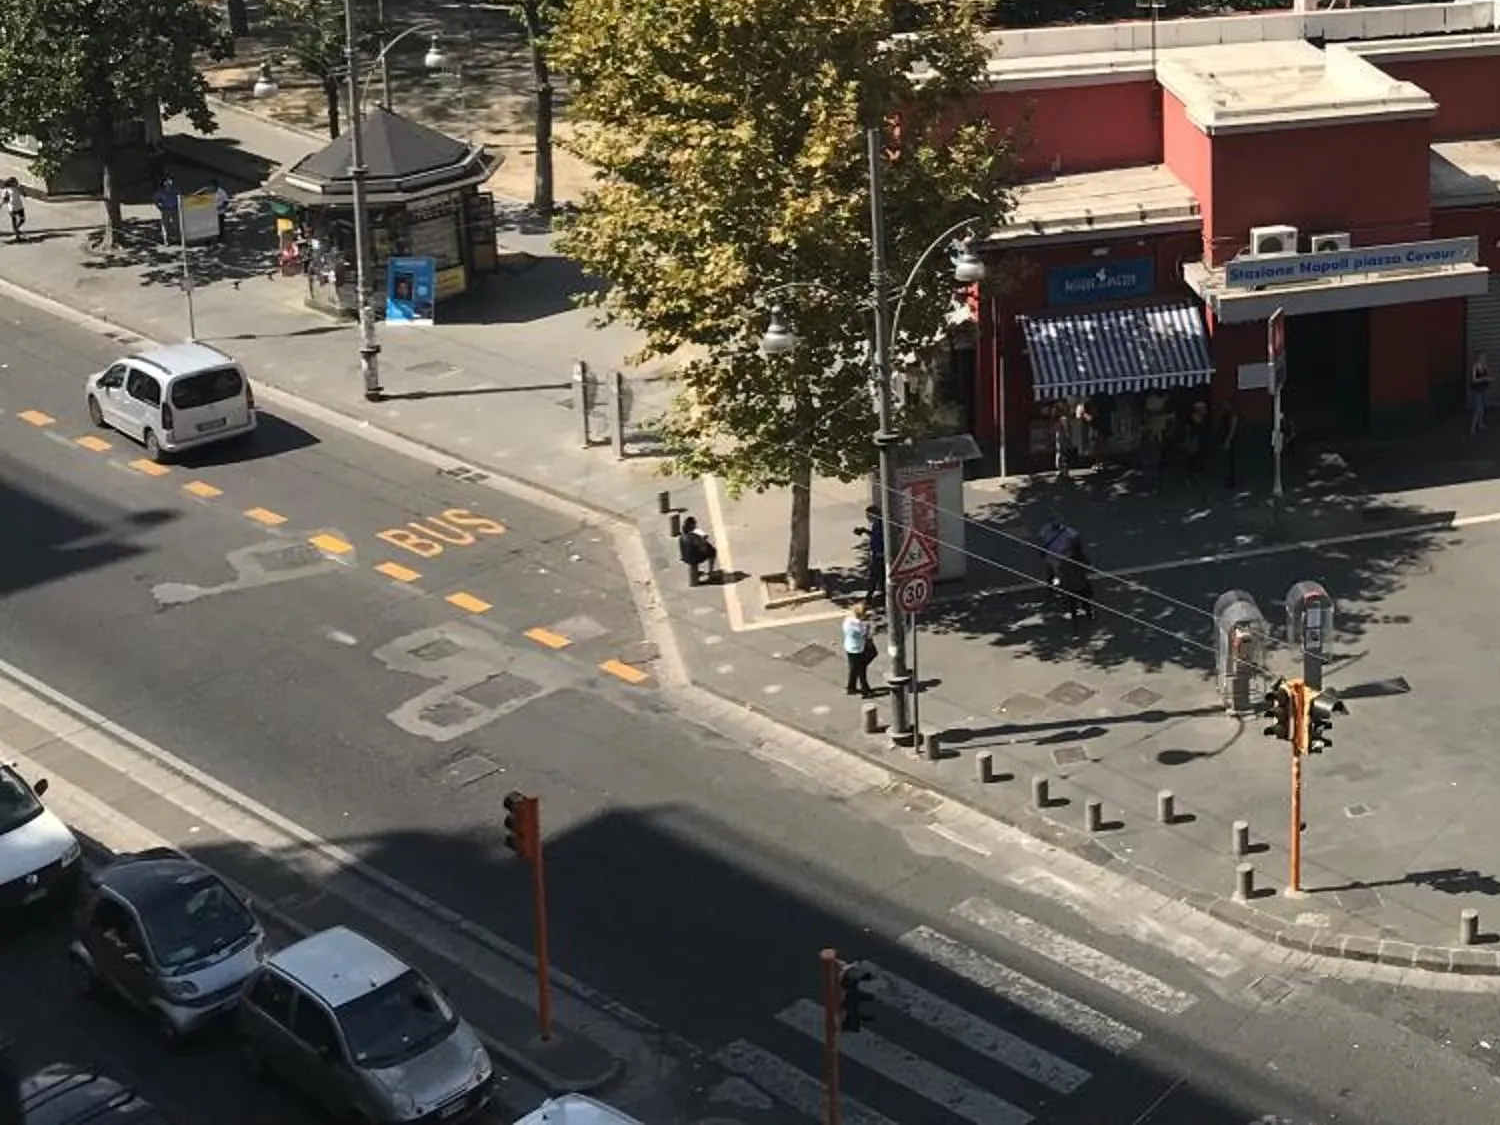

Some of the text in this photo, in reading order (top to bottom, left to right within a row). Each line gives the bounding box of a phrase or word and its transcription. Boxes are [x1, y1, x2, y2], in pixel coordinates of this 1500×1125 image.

[1229, 250, 1457, 281] Stazione Napoli piazza Cavour
[375, 508, 506, 558] BUS
[906, 581, 925, 604] 30
